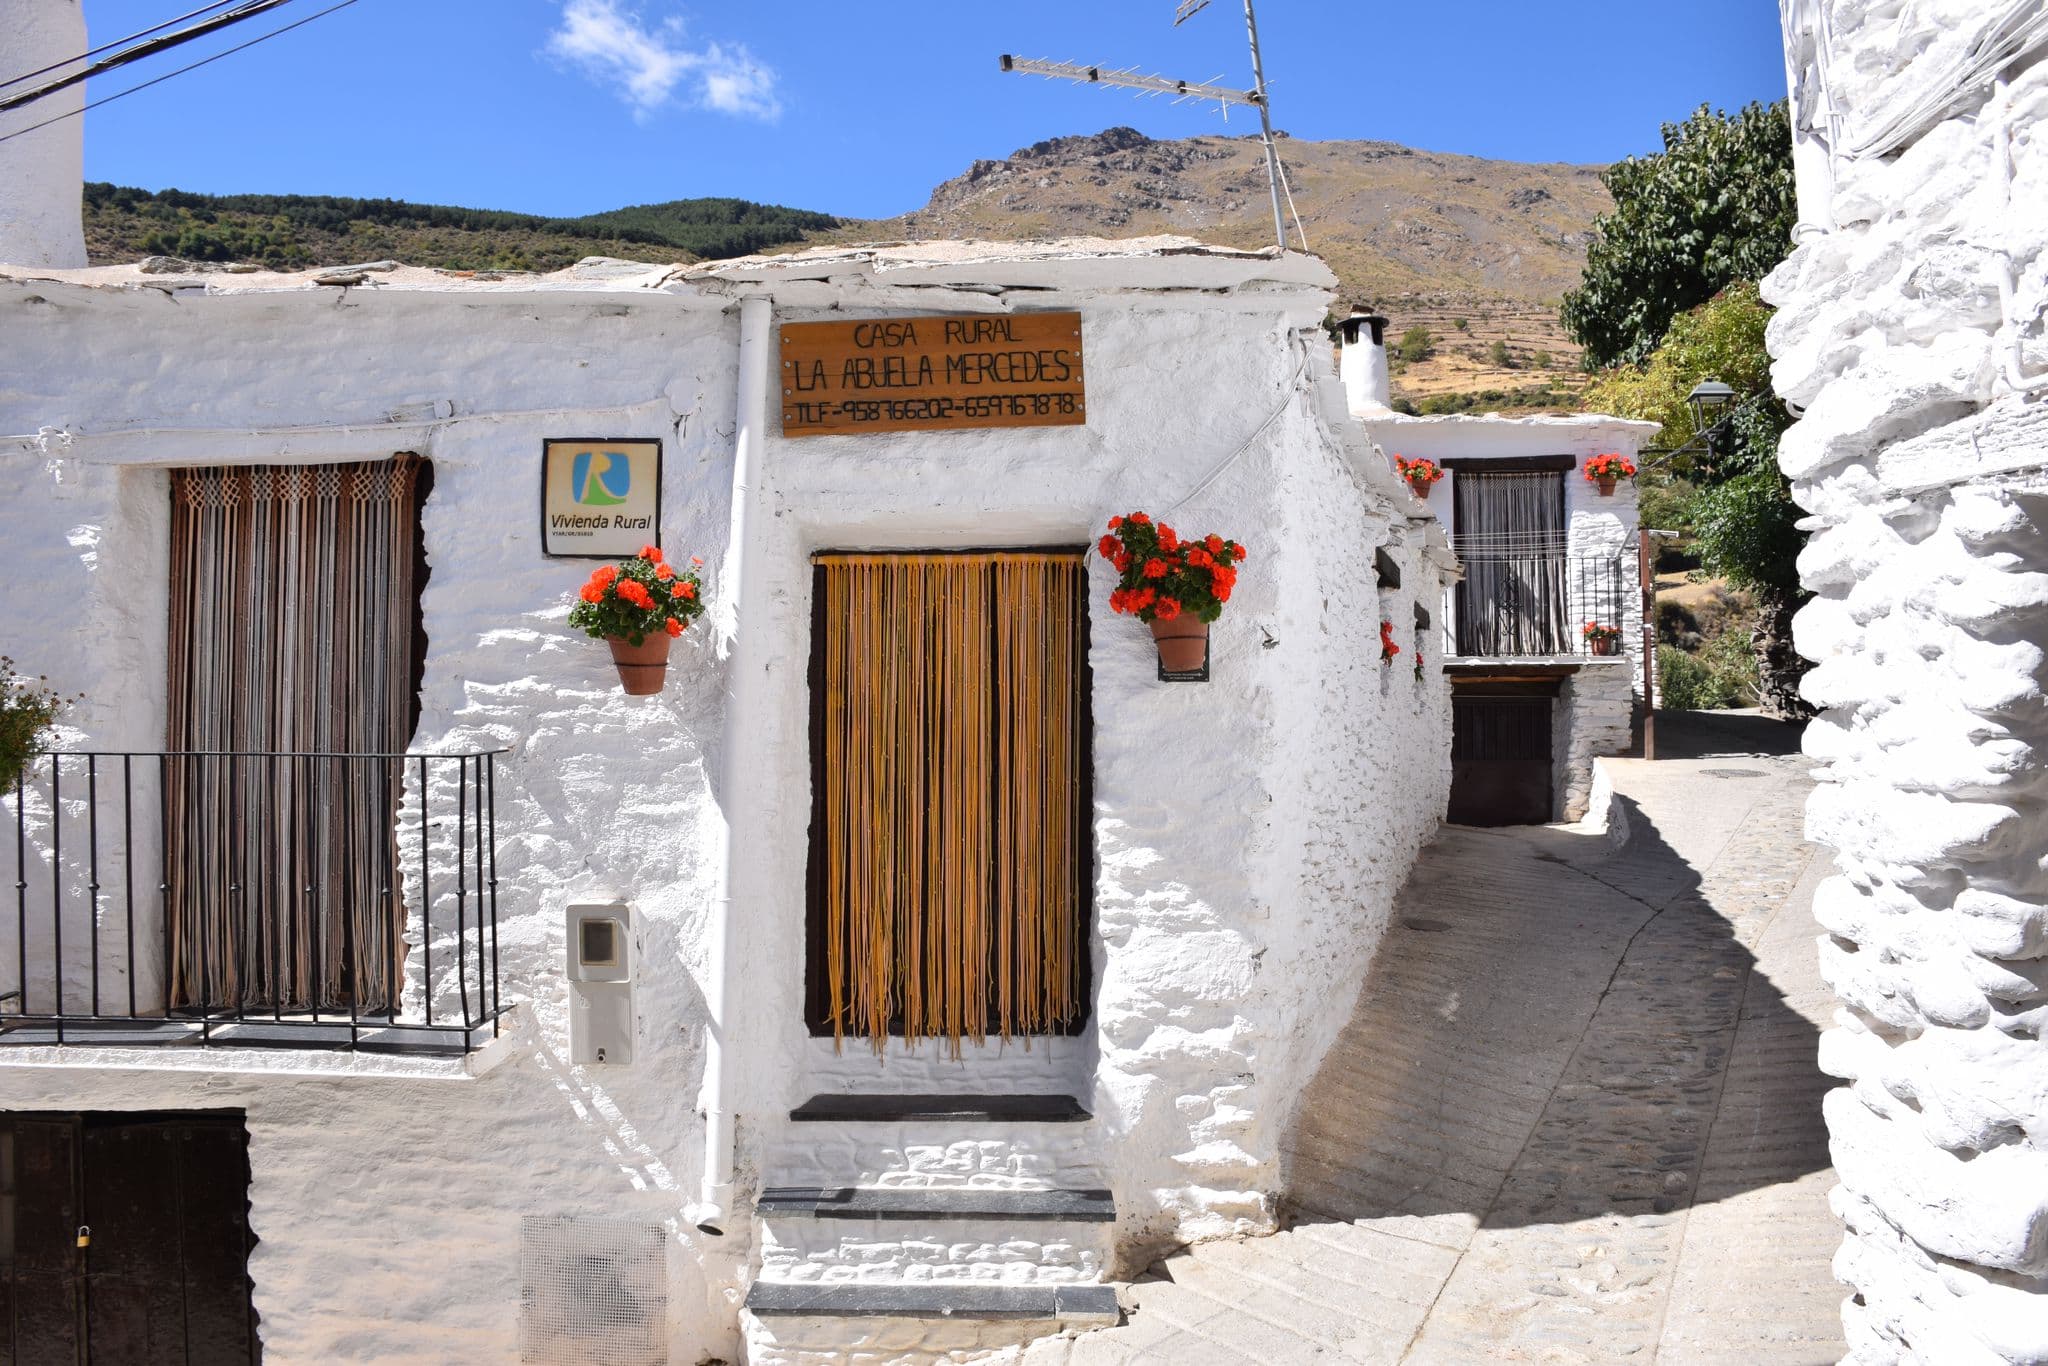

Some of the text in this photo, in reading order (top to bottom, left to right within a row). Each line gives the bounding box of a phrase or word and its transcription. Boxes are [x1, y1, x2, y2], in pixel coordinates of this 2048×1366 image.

[854, 319, 1023, 348] CASA RURAL
[794, 350, 1071, 391] LA ABUELA MERCEDES
[552, 515, 651, 529] Vivienda Rural
